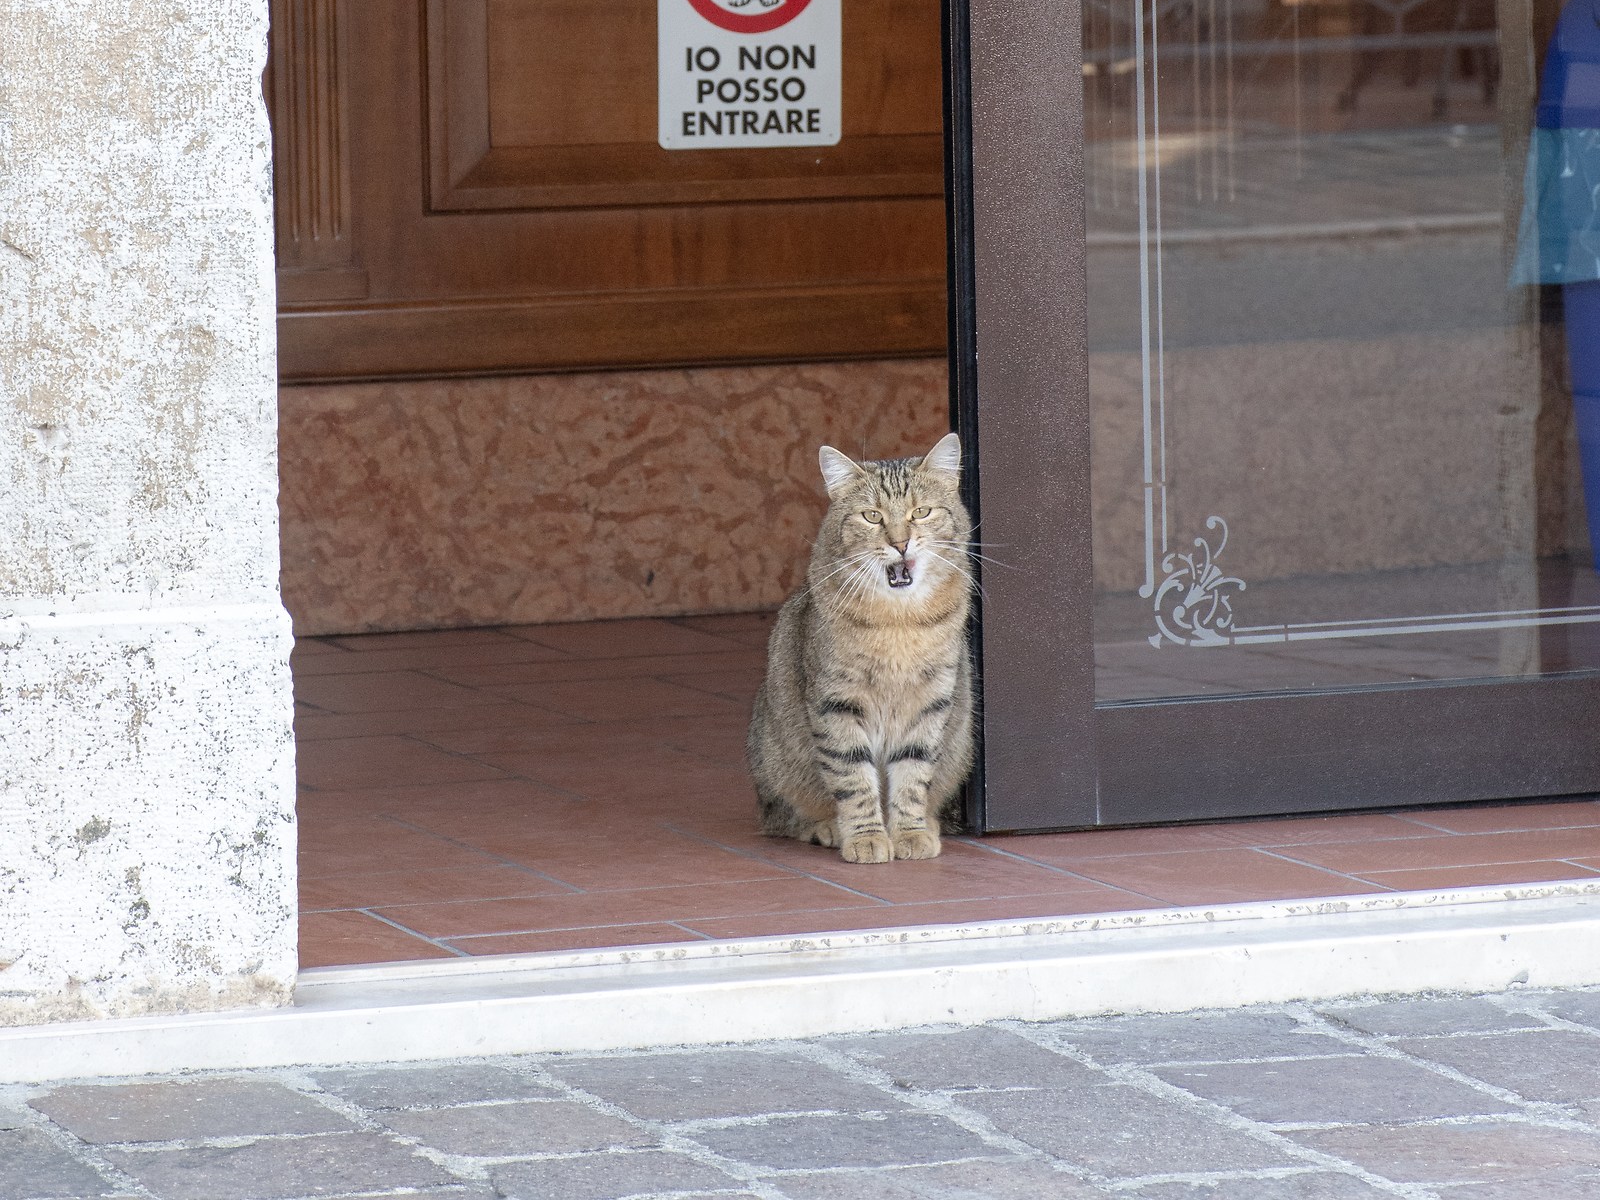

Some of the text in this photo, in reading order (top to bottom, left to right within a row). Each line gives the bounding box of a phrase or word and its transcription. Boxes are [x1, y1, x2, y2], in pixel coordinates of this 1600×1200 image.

[685, 44, 816, 72] IO NON
[697, 77, 806, 104] POSSO
[682, 108, 821, 137] ENTRARE
